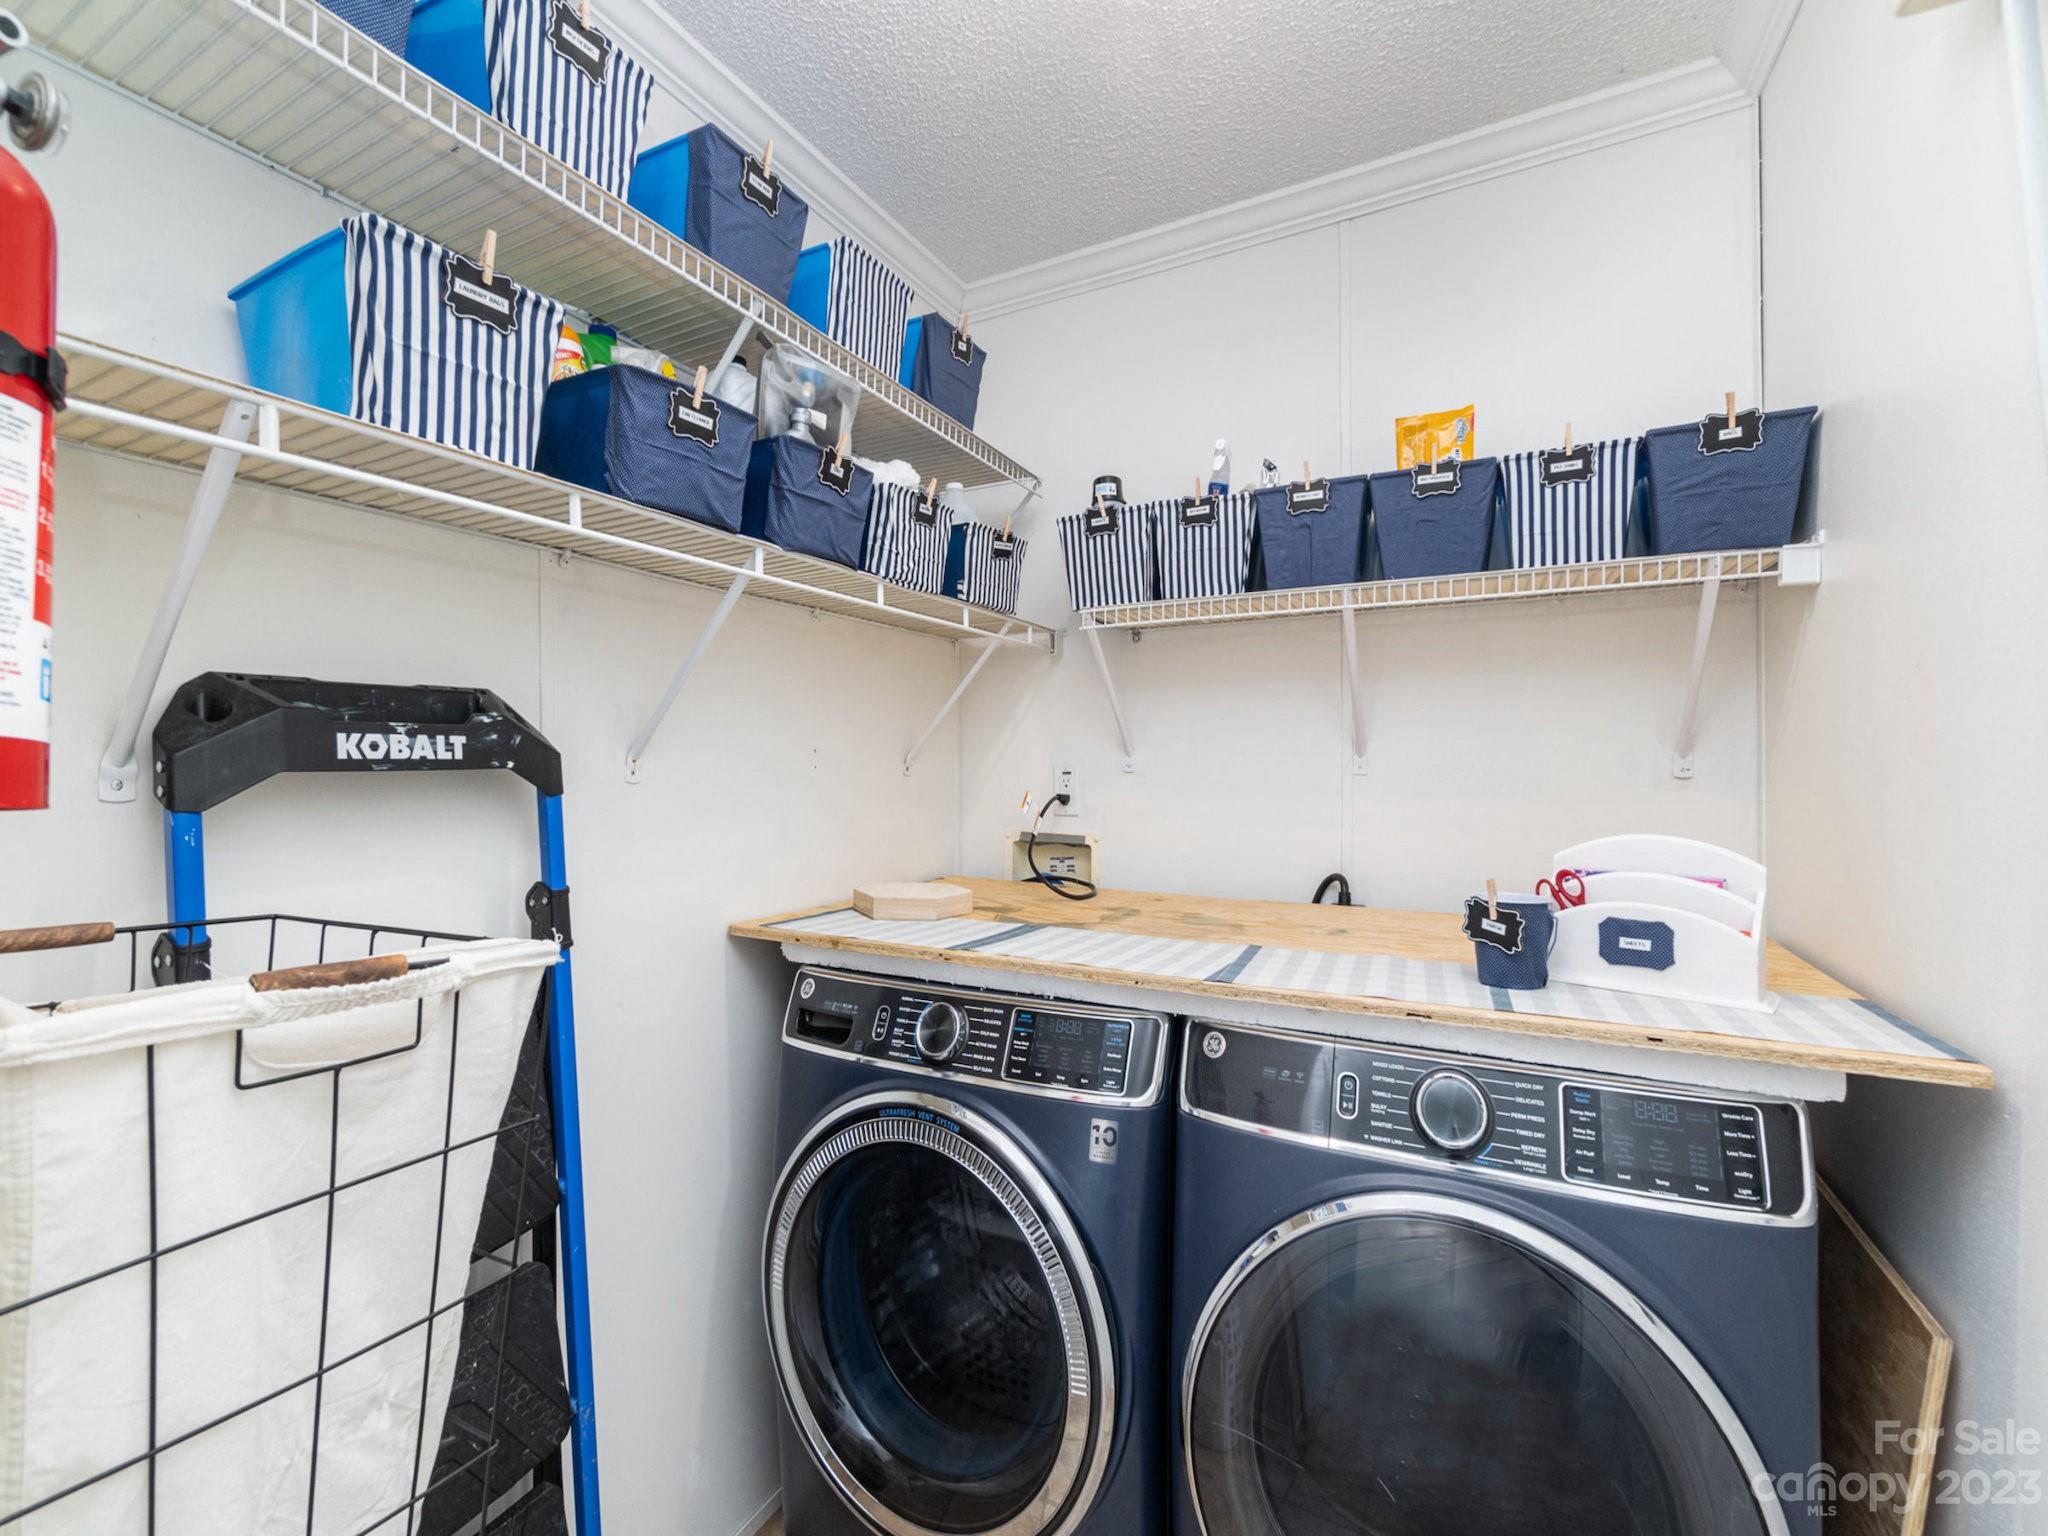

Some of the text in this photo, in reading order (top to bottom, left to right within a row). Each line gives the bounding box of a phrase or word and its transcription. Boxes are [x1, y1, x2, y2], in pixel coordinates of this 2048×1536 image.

[336, 732, 467, 760] KOBALT
[1372, 1075, 1395, 1083] COTTONS
[1372, 1090, 1391, 1098] TOWELS
[1515, 1097, 1545, 1106] DELICATES
[879, 1107, 961, 1134] ULTRAFRESH VENT SYSTEM
[1511, 1112, 1545, 1123] PERM PRESS
[1371, 1120, 1393, 1129] SANITIZE
[1092, 1125, 1118, 1147] 10
[1534, 1131, 1545, 1139] DRY
[1521, 1145, 1547, 1154] REFRESH
[1514, 1159, 1547, 1170] DEWRINKLE
[1577, 1165, 1594, 1174] Sound
[1655, 1178, 1670, 1187] Temp
[1695, 1184, 1709, 1192] Time
